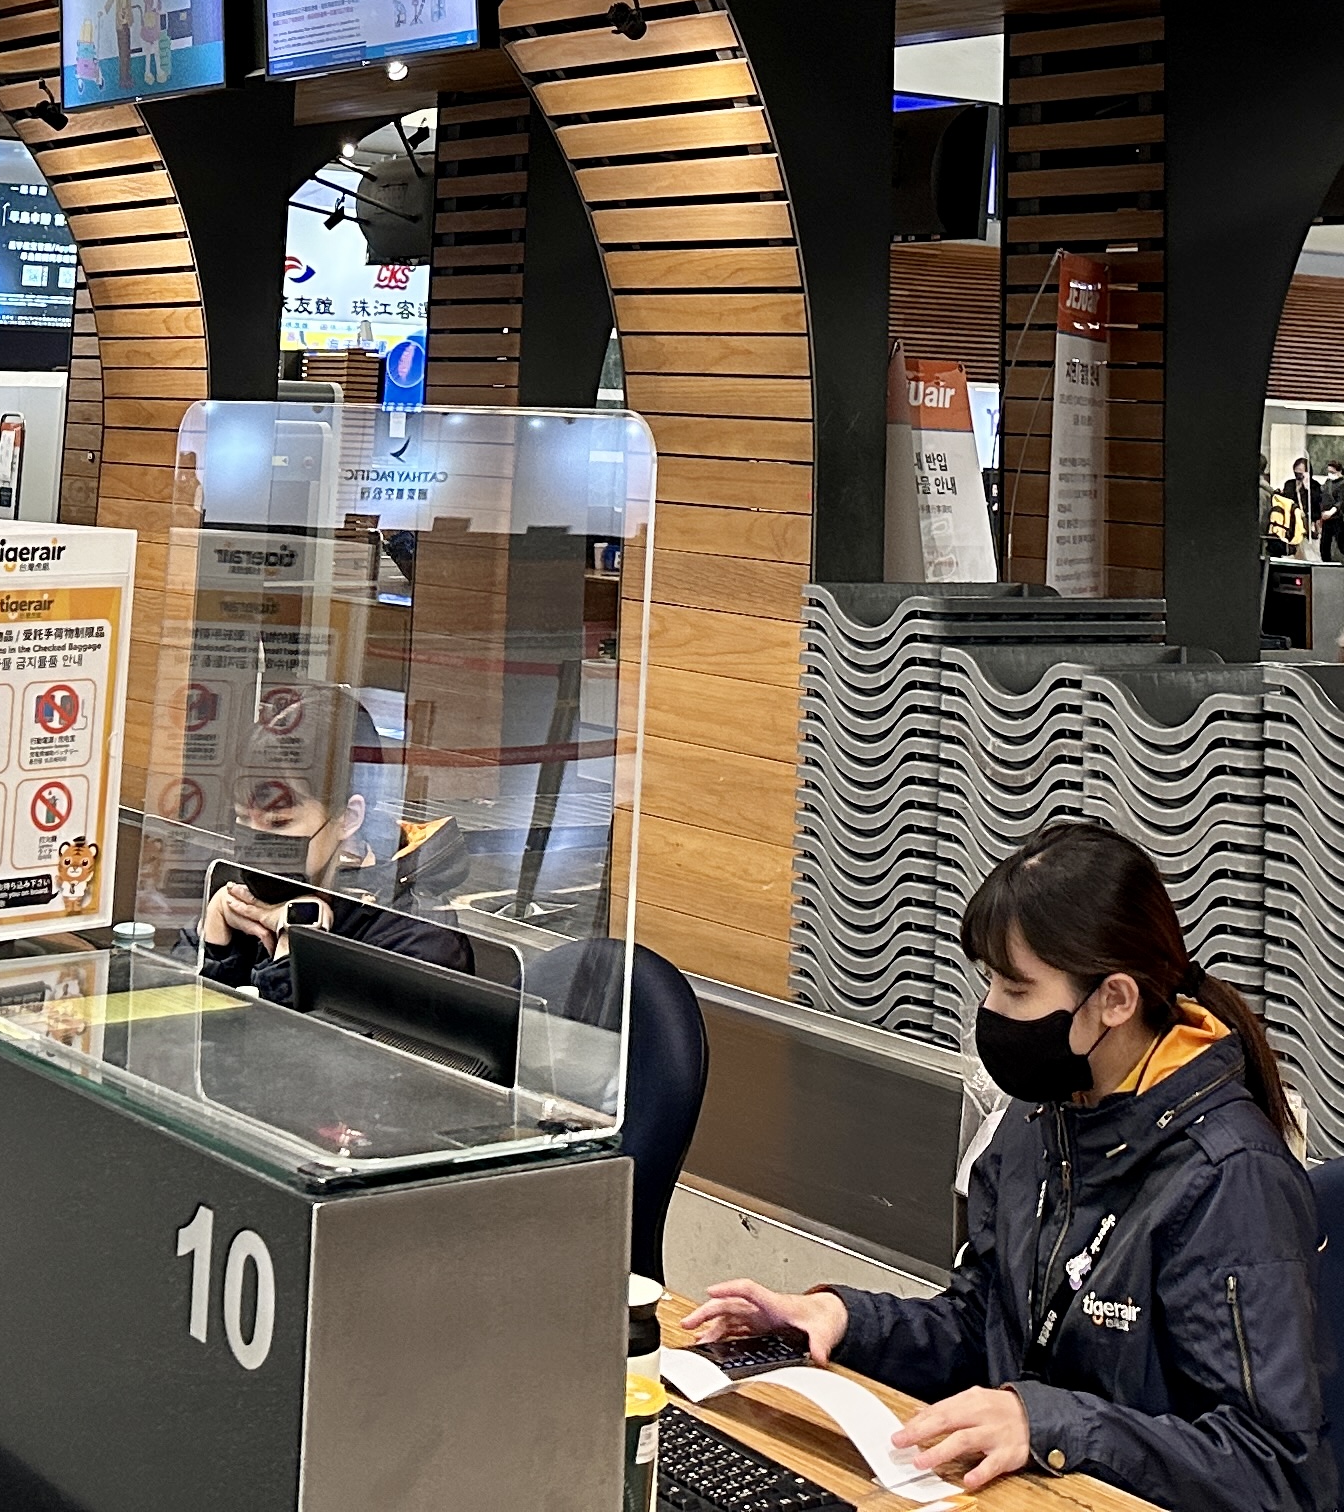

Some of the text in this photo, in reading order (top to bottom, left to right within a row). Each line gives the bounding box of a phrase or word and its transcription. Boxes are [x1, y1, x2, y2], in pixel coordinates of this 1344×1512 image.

[375, 265, 410, 285] CKS
[925, 451, 948, 473] 반입
[934, 475, 957, 496] 안내
[0, 593, 55, 620] tigerair
[18, 645, 31, 654] the
[32, 644, 67, 653] Checked
[68, 642, 102, 652] Baggage
[62, 654, 83, 668] 안내
[176, 1204, 275, 1370] 10
[1082, 1291, 1142, 1326] tigerair
